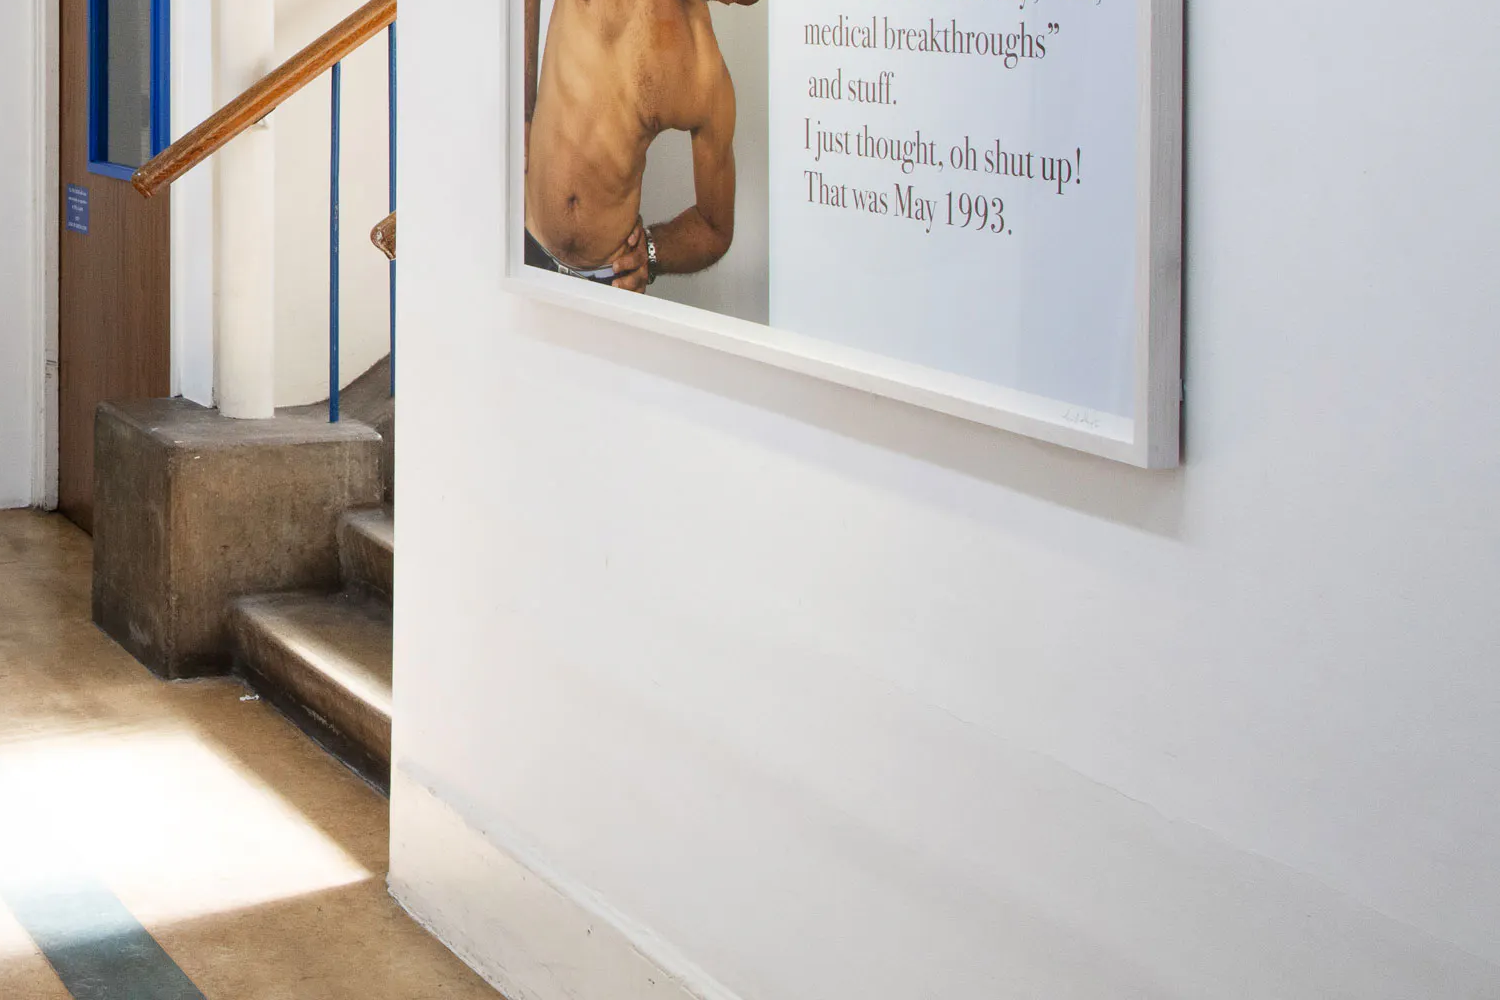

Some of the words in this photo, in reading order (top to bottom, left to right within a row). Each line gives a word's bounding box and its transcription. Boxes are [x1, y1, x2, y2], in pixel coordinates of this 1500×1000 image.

[804, 15, 878, 49] medical
[883, 17, 1061, 69] breakthroughs”
[808, 68, 842, 100] and
[847, 71, 898, 105] stuff.
[804, 117, 812, 149] I
[814, 120, 851, 163] just
[856, 125, 944, 174] thought,
[949, 134, 978, 172] oh
[984, 139, 1035, 180] shut
[1041, 147, 1082, 195] up!
[804, 169, 848, 210] That
[851, 188, 889, 215] was
[894, 183, 938, 234] May
[945, 190, 1013, 236] 1993.
